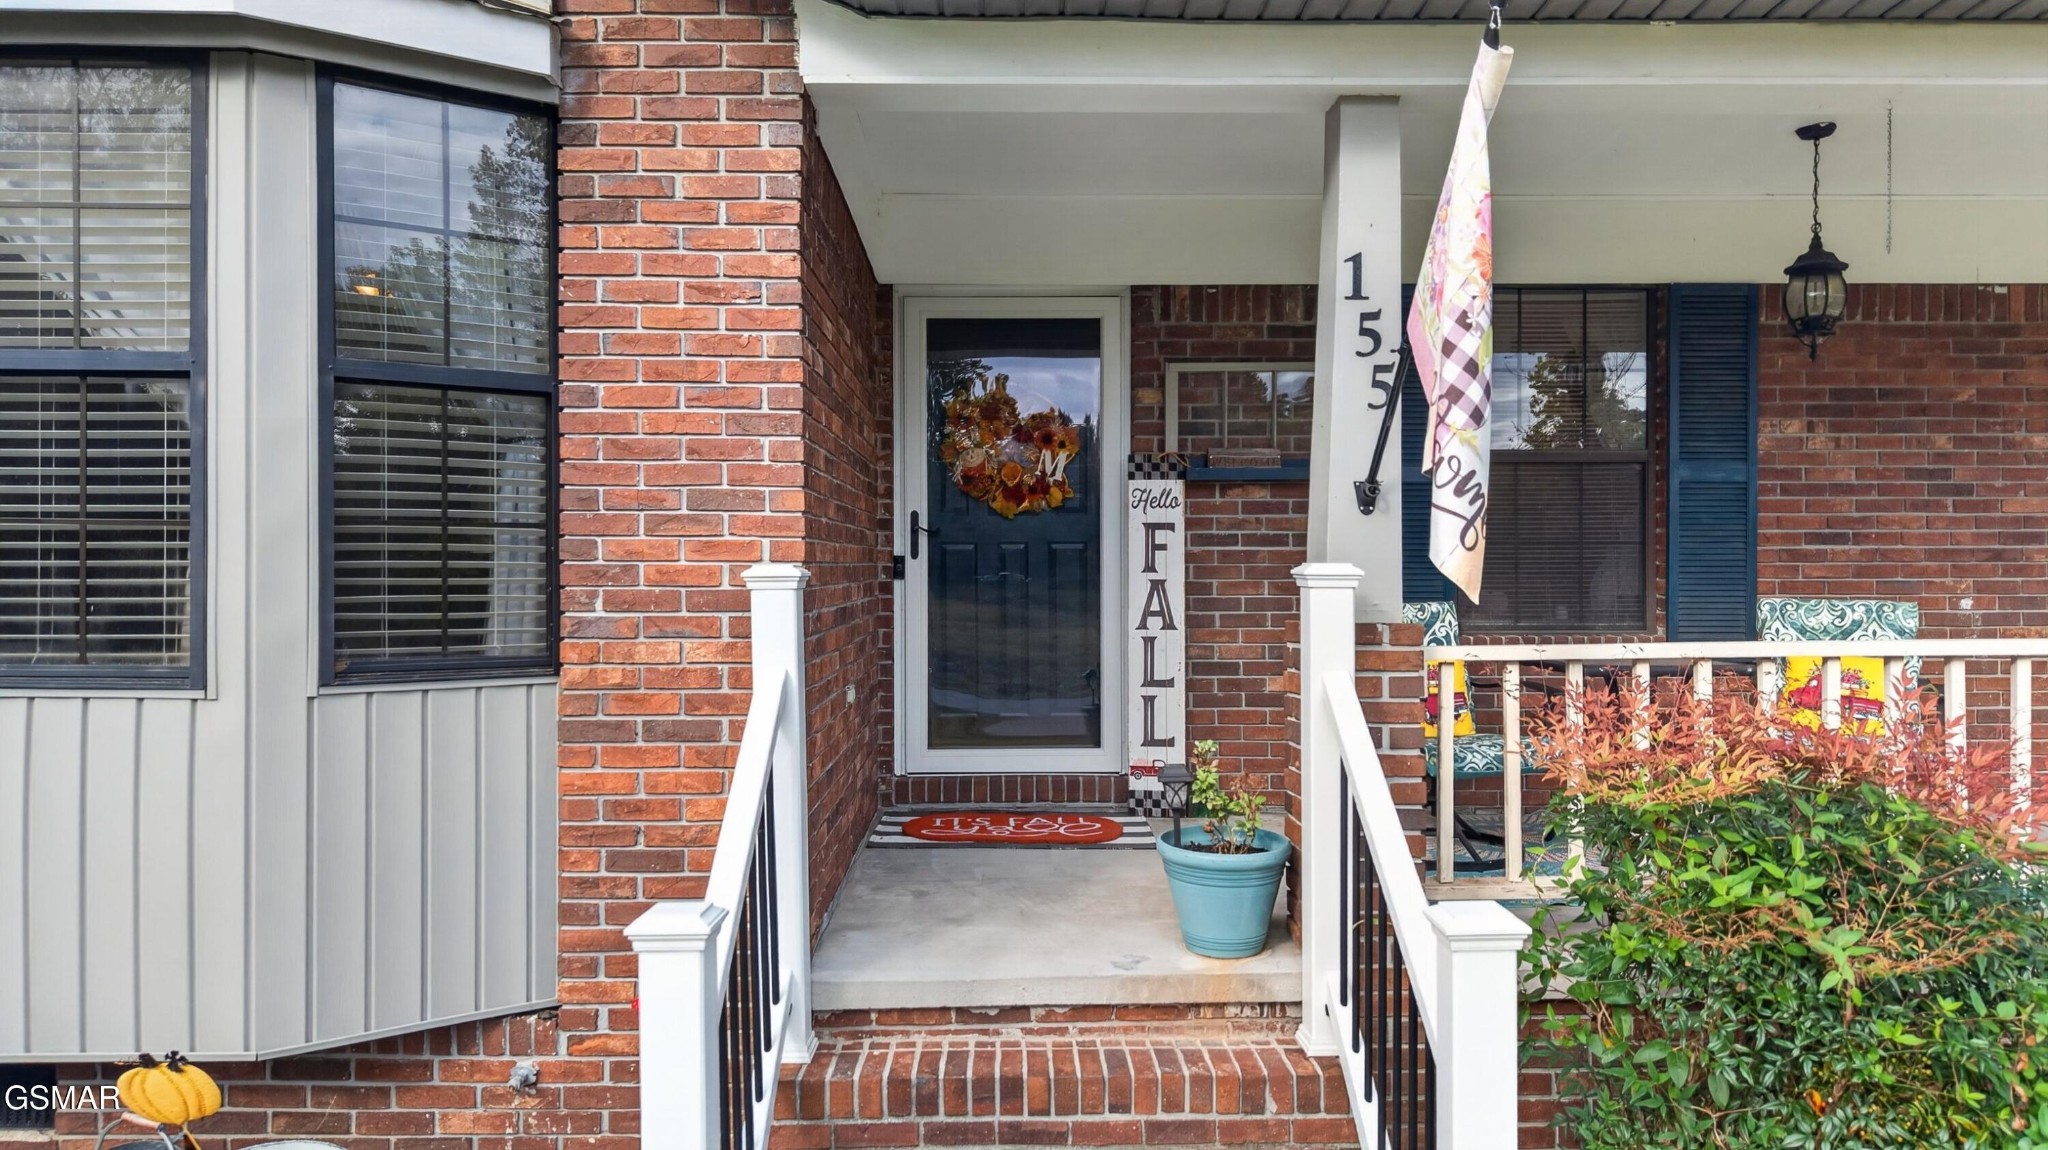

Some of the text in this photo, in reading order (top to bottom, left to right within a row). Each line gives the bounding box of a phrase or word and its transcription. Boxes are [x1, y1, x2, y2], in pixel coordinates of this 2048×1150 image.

[1343, 251, 1396, 411] 155
[1035, 449, 1069, 481] M
[1131, 487, 1182, 515] Hello
[1135, 522, 1178, 747] FALL
[1009, 815, 1086, 828] FALL
